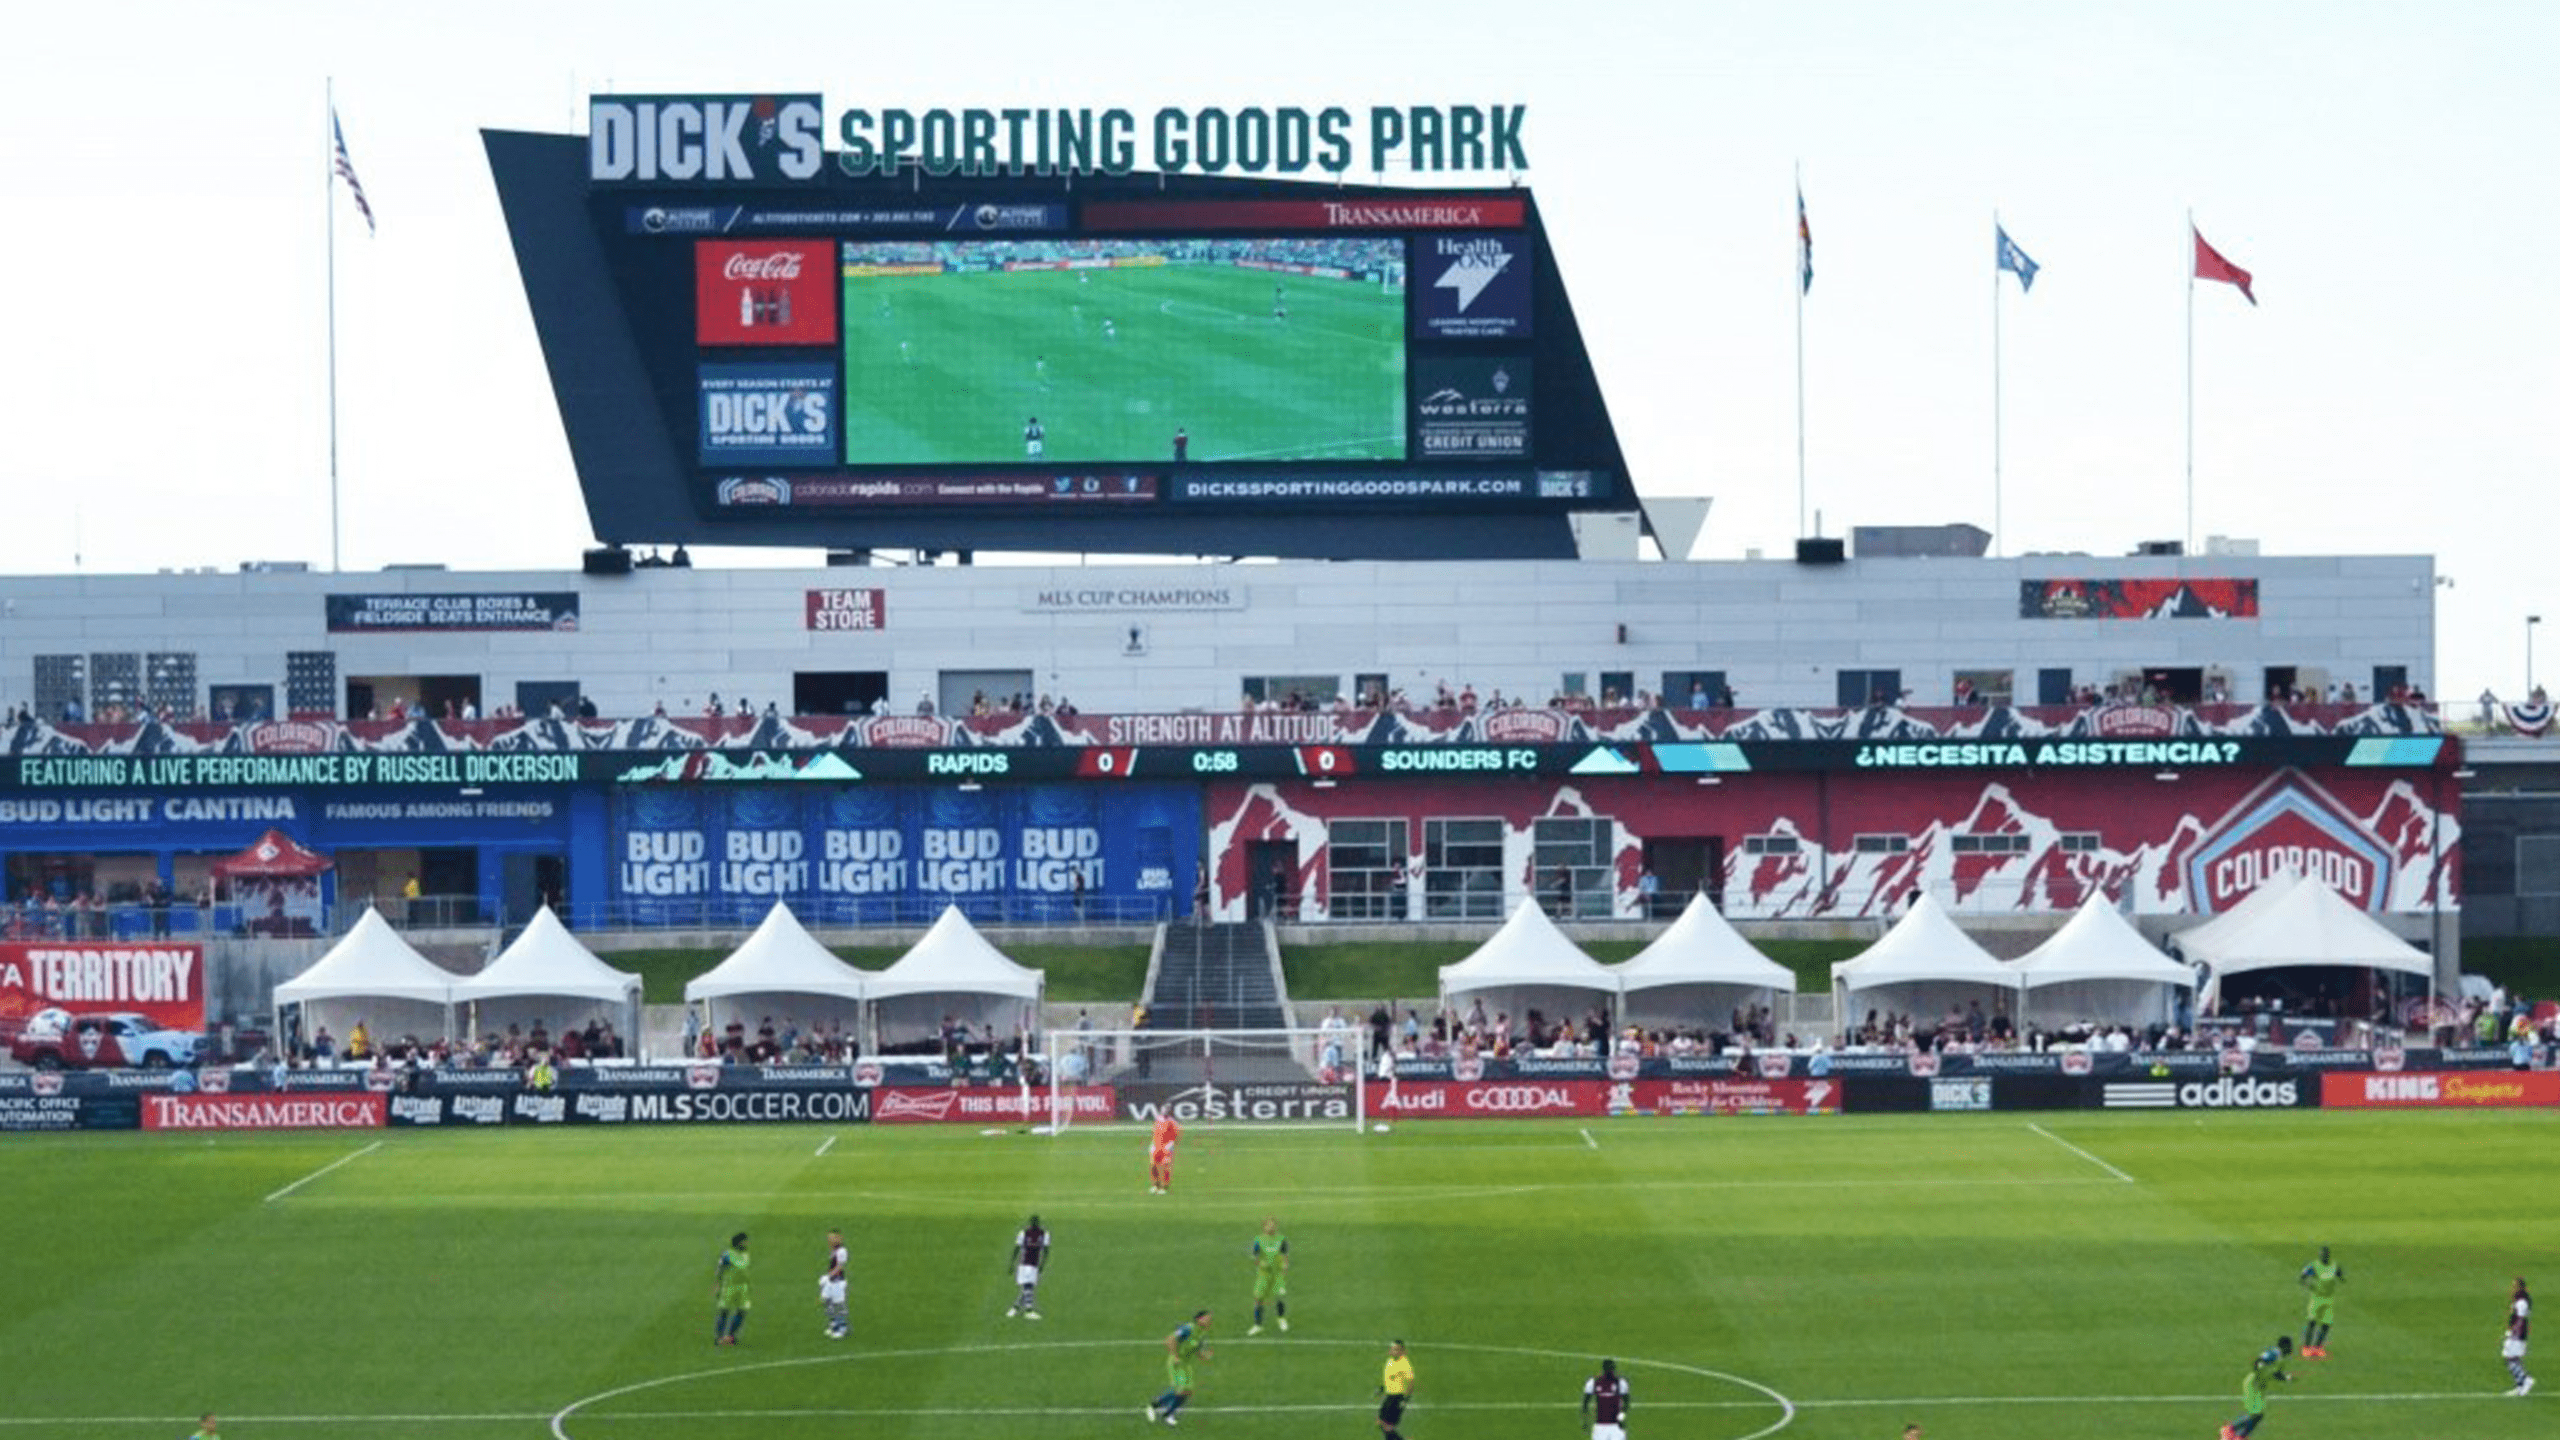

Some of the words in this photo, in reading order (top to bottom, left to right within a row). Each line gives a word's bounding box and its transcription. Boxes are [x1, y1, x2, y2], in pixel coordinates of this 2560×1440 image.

[590, 101, 822, 180] DICK'S
[840, 108, 1136, 177] SPORTING
[1154, 107, 1352, 173] GOODS
[1371, 104, 1530, 171] PARK
[1323, 202, 1481, 226] TRANSAMERICA
[1437, 238, 1503, 255] Health
[709, 392, 827, 432] DICK'S
[1419, 399, 1527, 415] westerra
[1423, 436, 1473, 449] CREDIT
[1476, 436, 1523, 449] UNION
[1187, 480, 1521, 496] DICKSSPORTINGGOODSPARK.COM
[365, 598, 431, 610] TERRACE
[433, 598, 472, 610] CLUB
[476, 598, 523, 610] BOXES
[526, 598, 536, 610] &
[820, 591, 871, 610] TEAM
[1037, 591, 1073, 607] MLS
[1078, 590, 1116, 605] CUP
[1118, 589, 1231, 606] CHAMPIONS
[354, 610, 425, 624] FIELDSIDE
[428, 610, 473, 623] SEATS
[475, 609, 551, 623] ENTRANCE
[815, 610, 876, 630] STORE
[1108, 716, 1213, 744] STRENGTH
[1219, 716, 1245, 742] AT
[1250, 715, 1341, 742] ALTITUDE
[928, 754, 1008, 774] RAPIDS
[1098, 753, 1114, 773] 0
[1193, 753, 1237, 773] 0:58
[1319, 752, 1334, 771] 0
[1381, 750, 1502, 771] SOUNDERS
[1507, 750, 1537, 769] FC
[1856, 744, 2026, 767] ¿NECESITA
[2039, 742, 2240, 764] ASISTENCIA?
[21, 758, 127, 785] FEATURING
[131, 758, 146, 784] A
[151, 758, 194, 785] LIVE
[197, 757, 339, 784] PERFORMANCE
[344, 757, 372, 783] BY
[377, 756, 462, 783] RUSSELL
[466, 755, 579, 782] DICKERSON
[0, 800, 62, 822] BUD
[64, 799, 154, 821] LIGHT
[163, 797, 297, 820] CANTINA
[325, 803, 402, 820] FAMOUS
[405, 803, 473, 819] AMONG
[476, 802, 553, 818] FRIENDS
[628, 830, 704, 863] BUD
[726, 830, 804, 862] BUD
[825, 829, 902, 861] BUD
[923, 829, 1000, 860] BUD
[1022, 828, 1101, 860] BUD
[621, 862, 711, 896] LIGHT
[719, 861, 808, 895] LIGHT
[818, 860, 907, 894] LIGHT
[917, 859, 1006, 893] LIGHT
[1016, 859, 1105, 893] LIGHT
[2216, 845, 2363, 899] COLORADO
[27, 950, 194, 1001] TERRITORY
[1245, 1086, 1297, 1097] CREDIT
[1299, 1086, 1349, 1096] UNION
[1380, 1089, 1446, 1109] Audi
[1672, 1082, 1709, 1095] Rocky
[1711, 1081, 1771, 1094] Mountain
[2179, 1076, 2297, 1106] adidas
[2364, 1076, 2440, 1101] KING
[39, 1097, 81, 1109] OFFICE
[151, 1096, 377, 1127] TRANSAMERICA
[632, 1094, 870, 1120] MLSSOCCER.COM
[959, 1096, 993, 1112] THIS
[996, 1096, 1040, 1112] BUDS
[1044, 1095, 1074, 1111] FR
[1129, 1090, 1348, 1121] westerra
